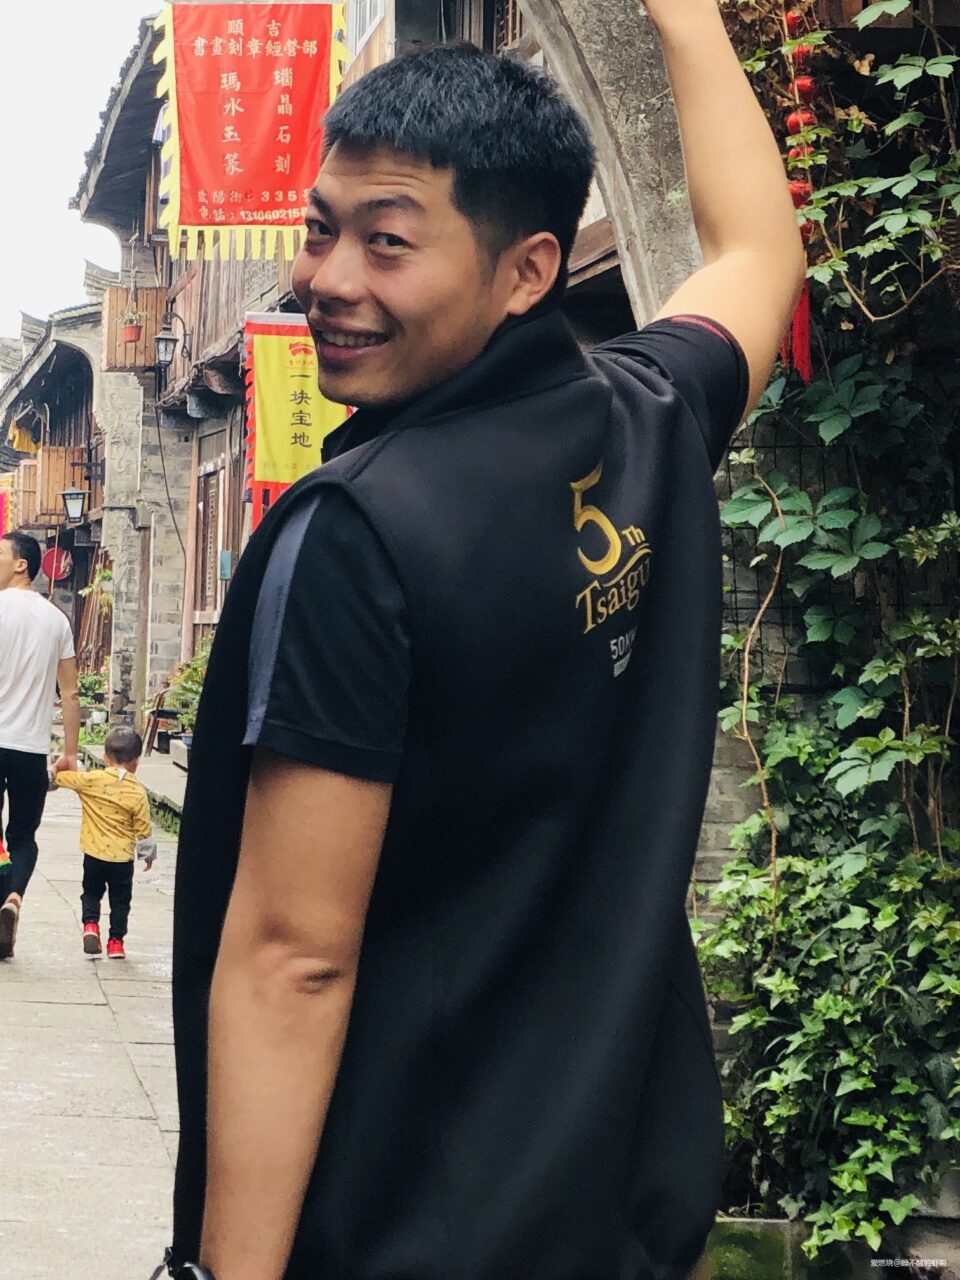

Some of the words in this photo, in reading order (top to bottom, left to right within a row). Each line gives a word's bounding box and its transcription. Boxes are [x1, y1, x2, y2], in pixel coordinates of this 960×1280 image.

[290, 373, 313, 448] 一块宝地
[570, 462, 622, 575] 5
